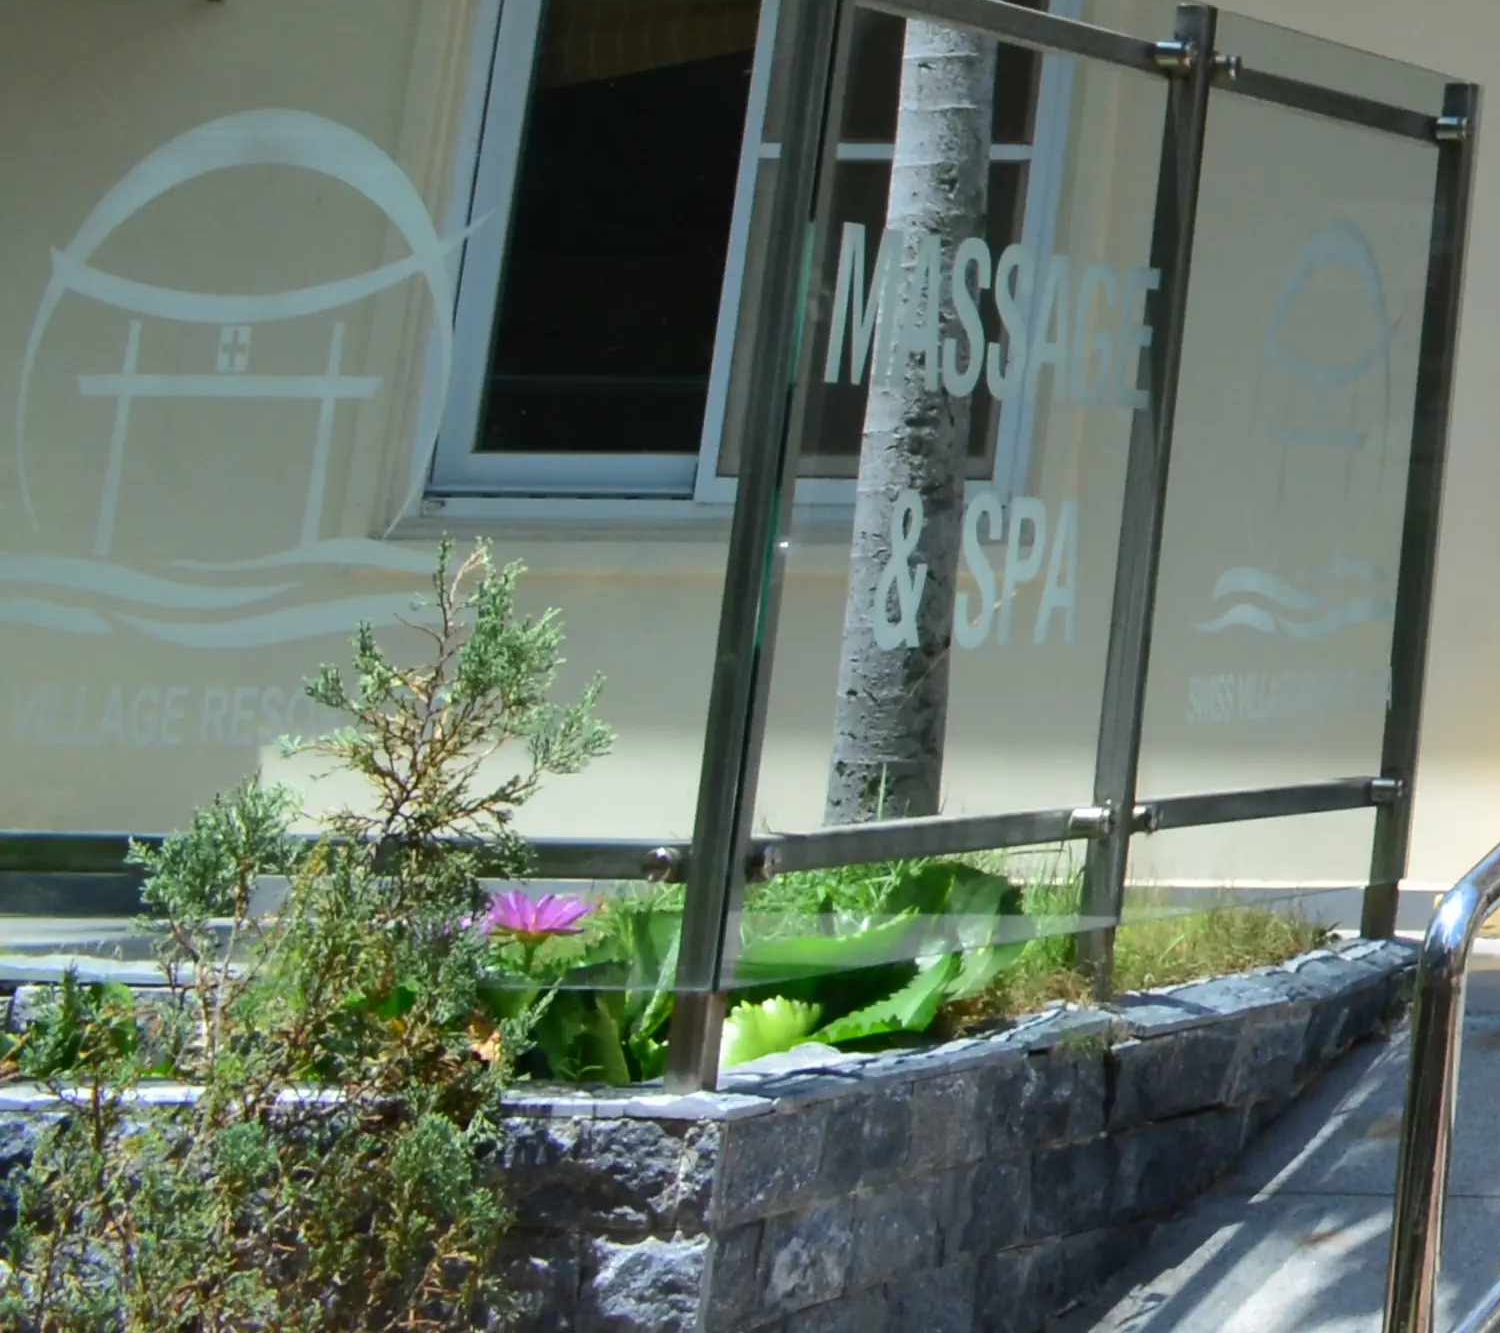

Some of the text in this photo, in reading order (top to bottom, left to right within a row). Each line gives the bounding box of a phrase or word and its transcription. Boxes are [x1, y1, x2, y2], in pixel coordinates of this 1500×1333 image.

[824, 221, 1161, 411] MASSAGE
[874, 489, 1079, 651] & SPA
[12, 683, 189, 746] VILLAGE
